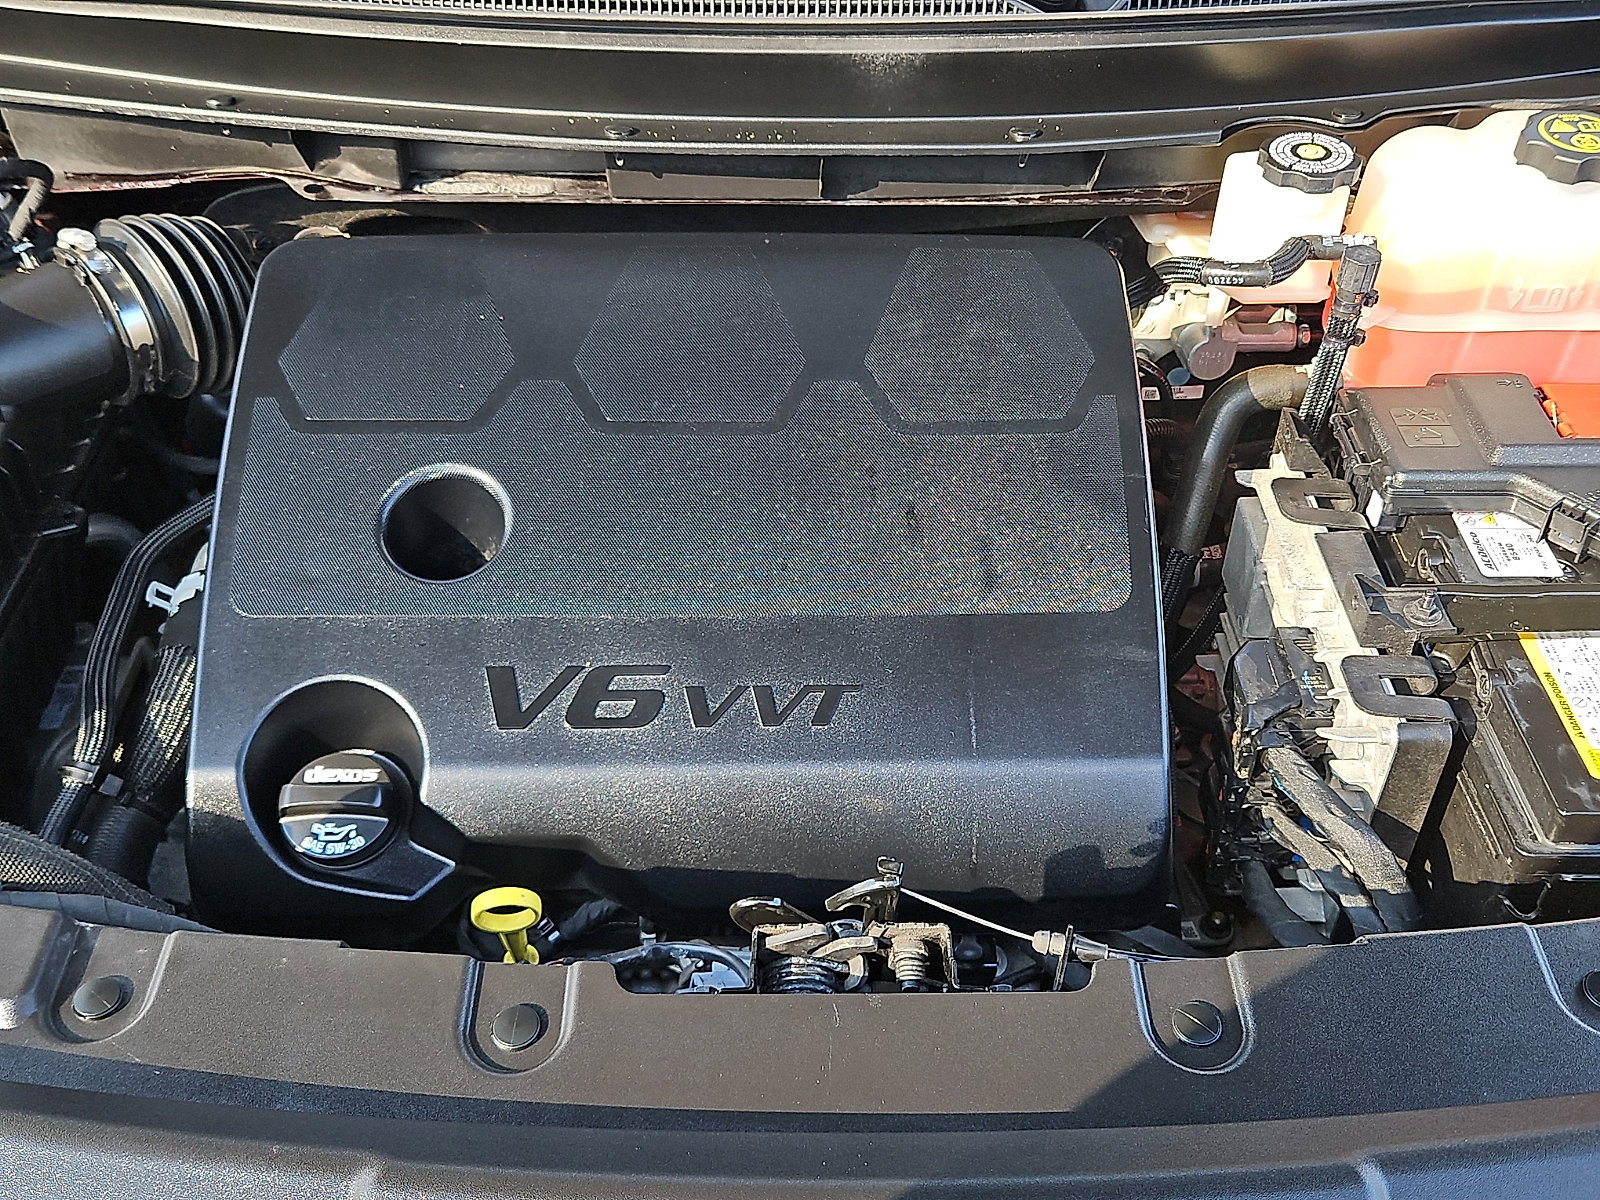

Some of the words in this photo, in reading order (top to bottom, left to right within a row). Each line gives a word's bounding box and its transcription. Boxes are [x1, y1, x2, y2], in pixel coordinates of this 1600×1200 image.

[486, 664, 672, 730] V6
[684, 684, 862, 728] VVT
[303, 765, 382, 784] dexos
[300, 836, 325, 855] SAE
[325, 835, 367, 855] 5W-30
